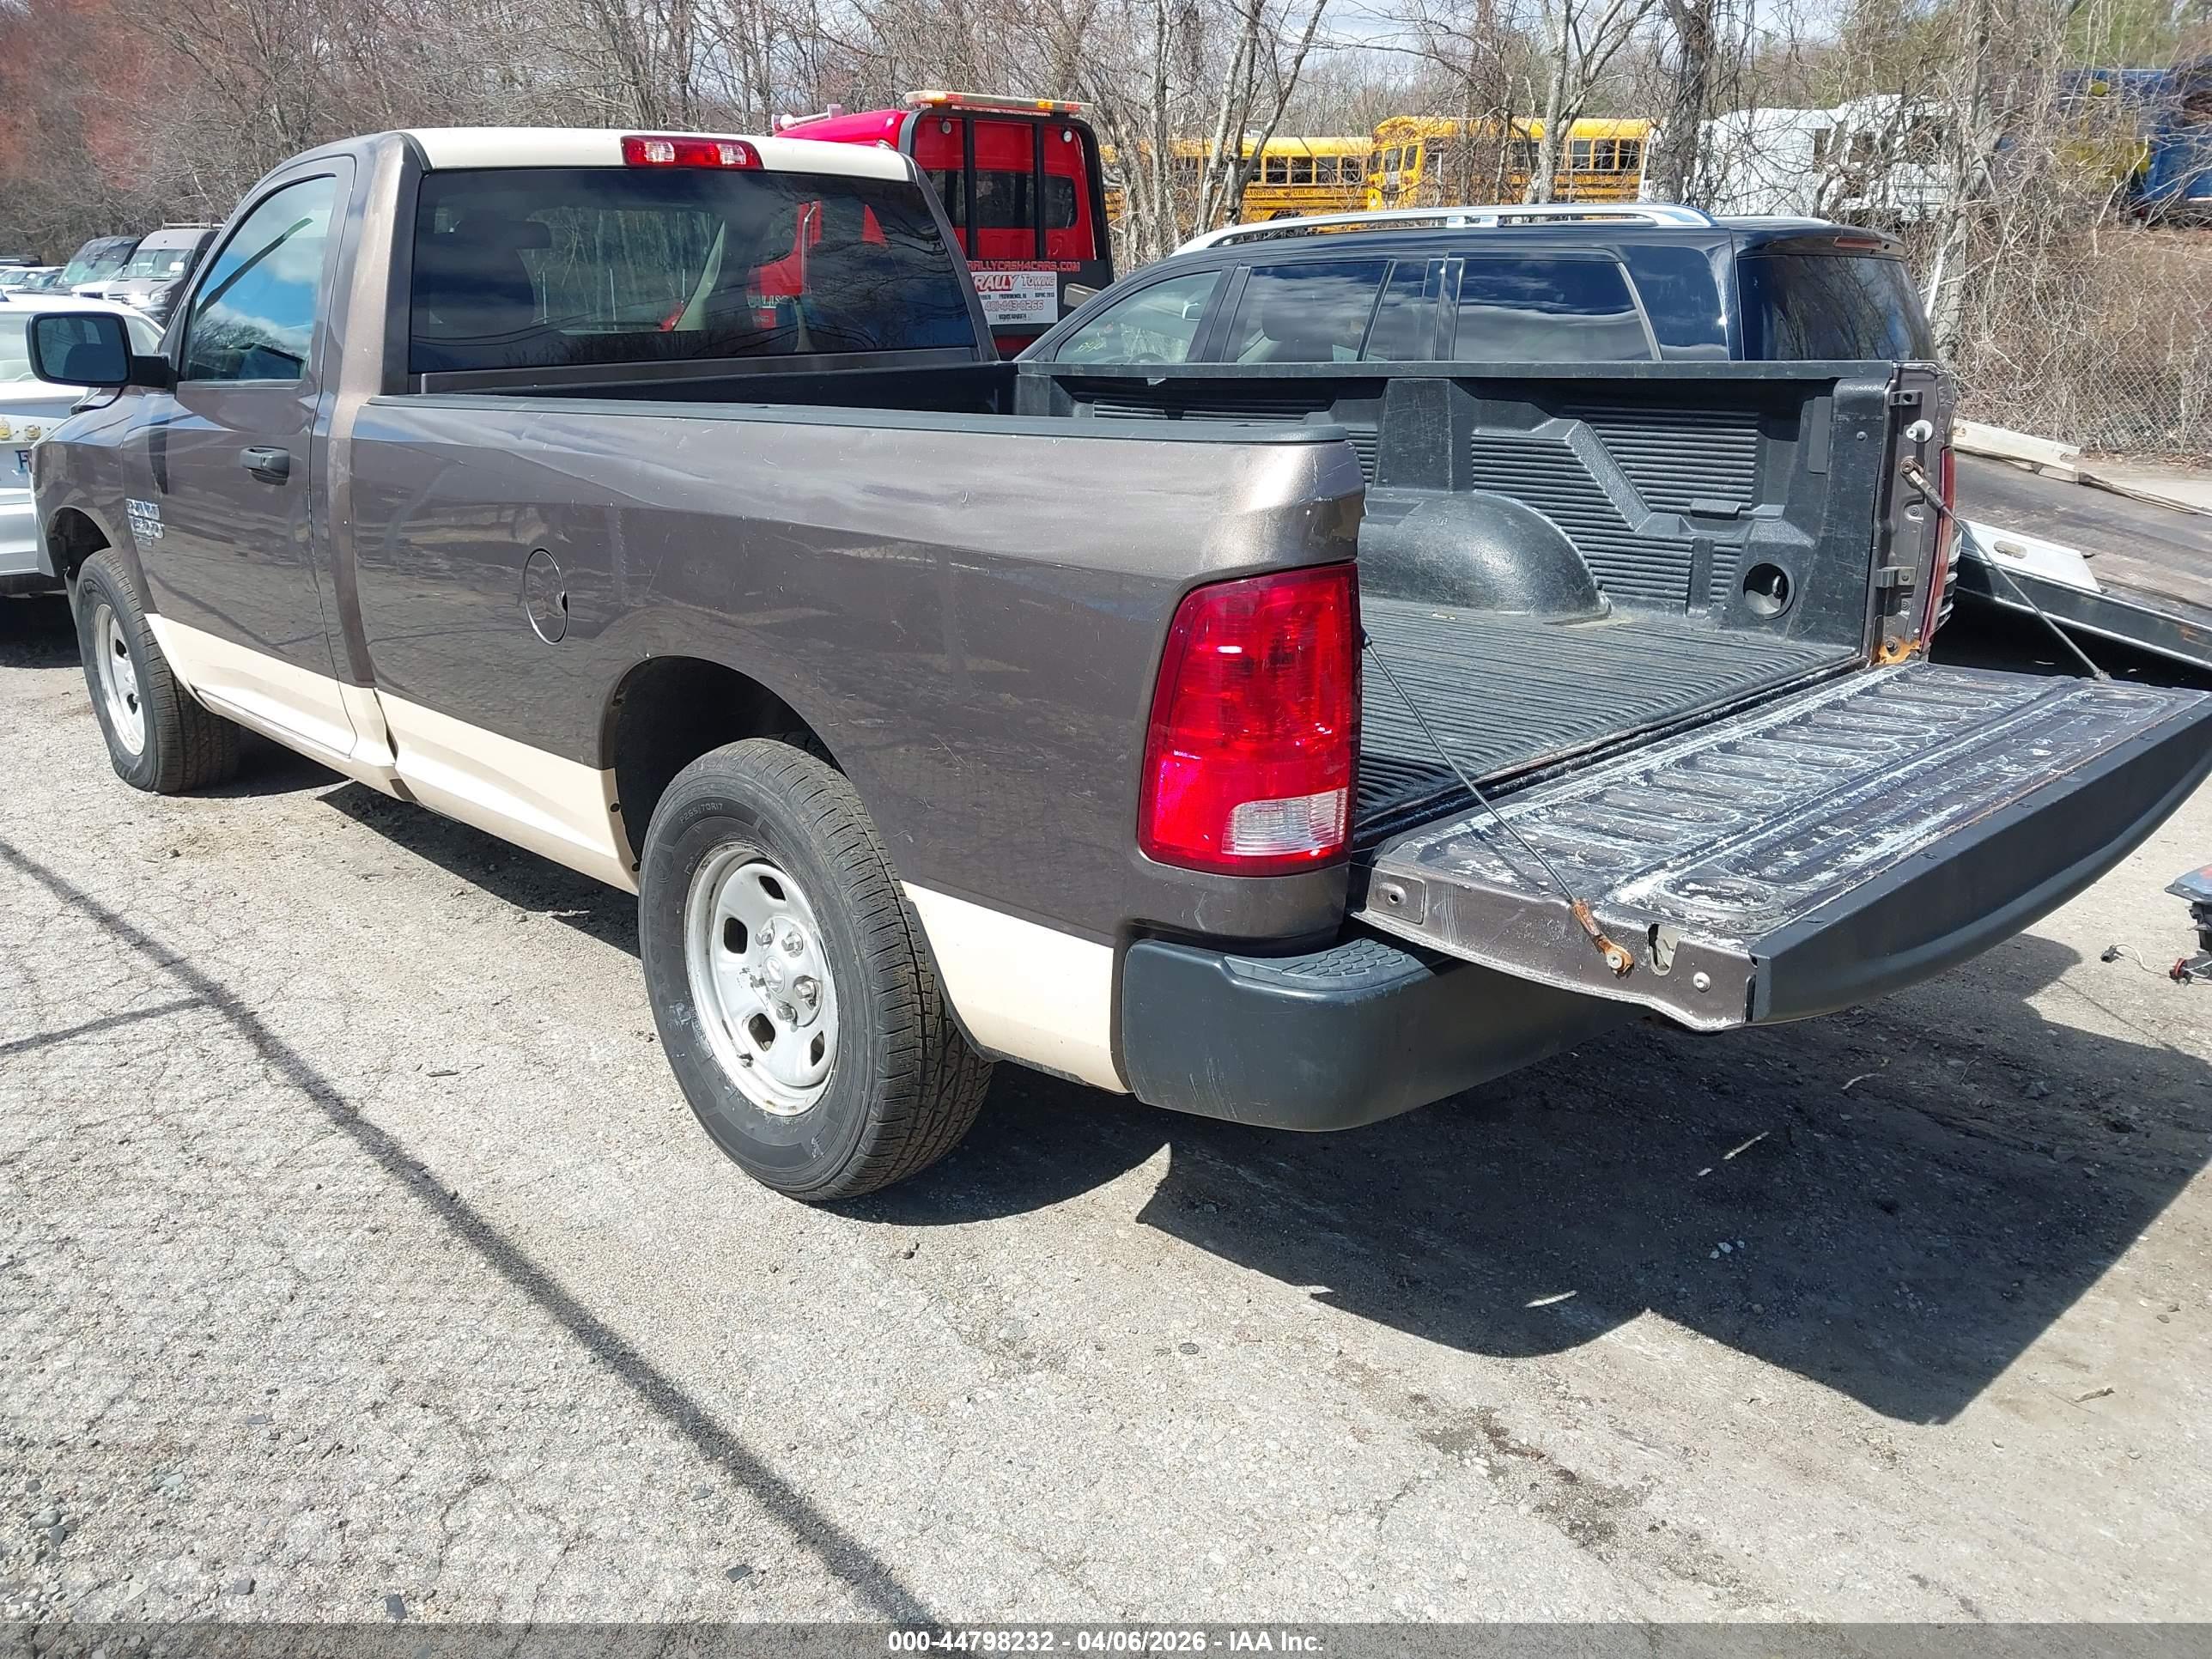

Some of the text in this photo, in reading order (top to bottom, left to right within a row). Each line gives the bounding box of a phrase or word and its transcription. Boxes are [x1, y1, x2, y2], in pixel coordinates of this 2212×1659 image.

[974, 275, 1018, 292] RALLY
[985, 301, 1043, 311] 401-443-0266
[678, 802, 723, 824] P265/70R17
